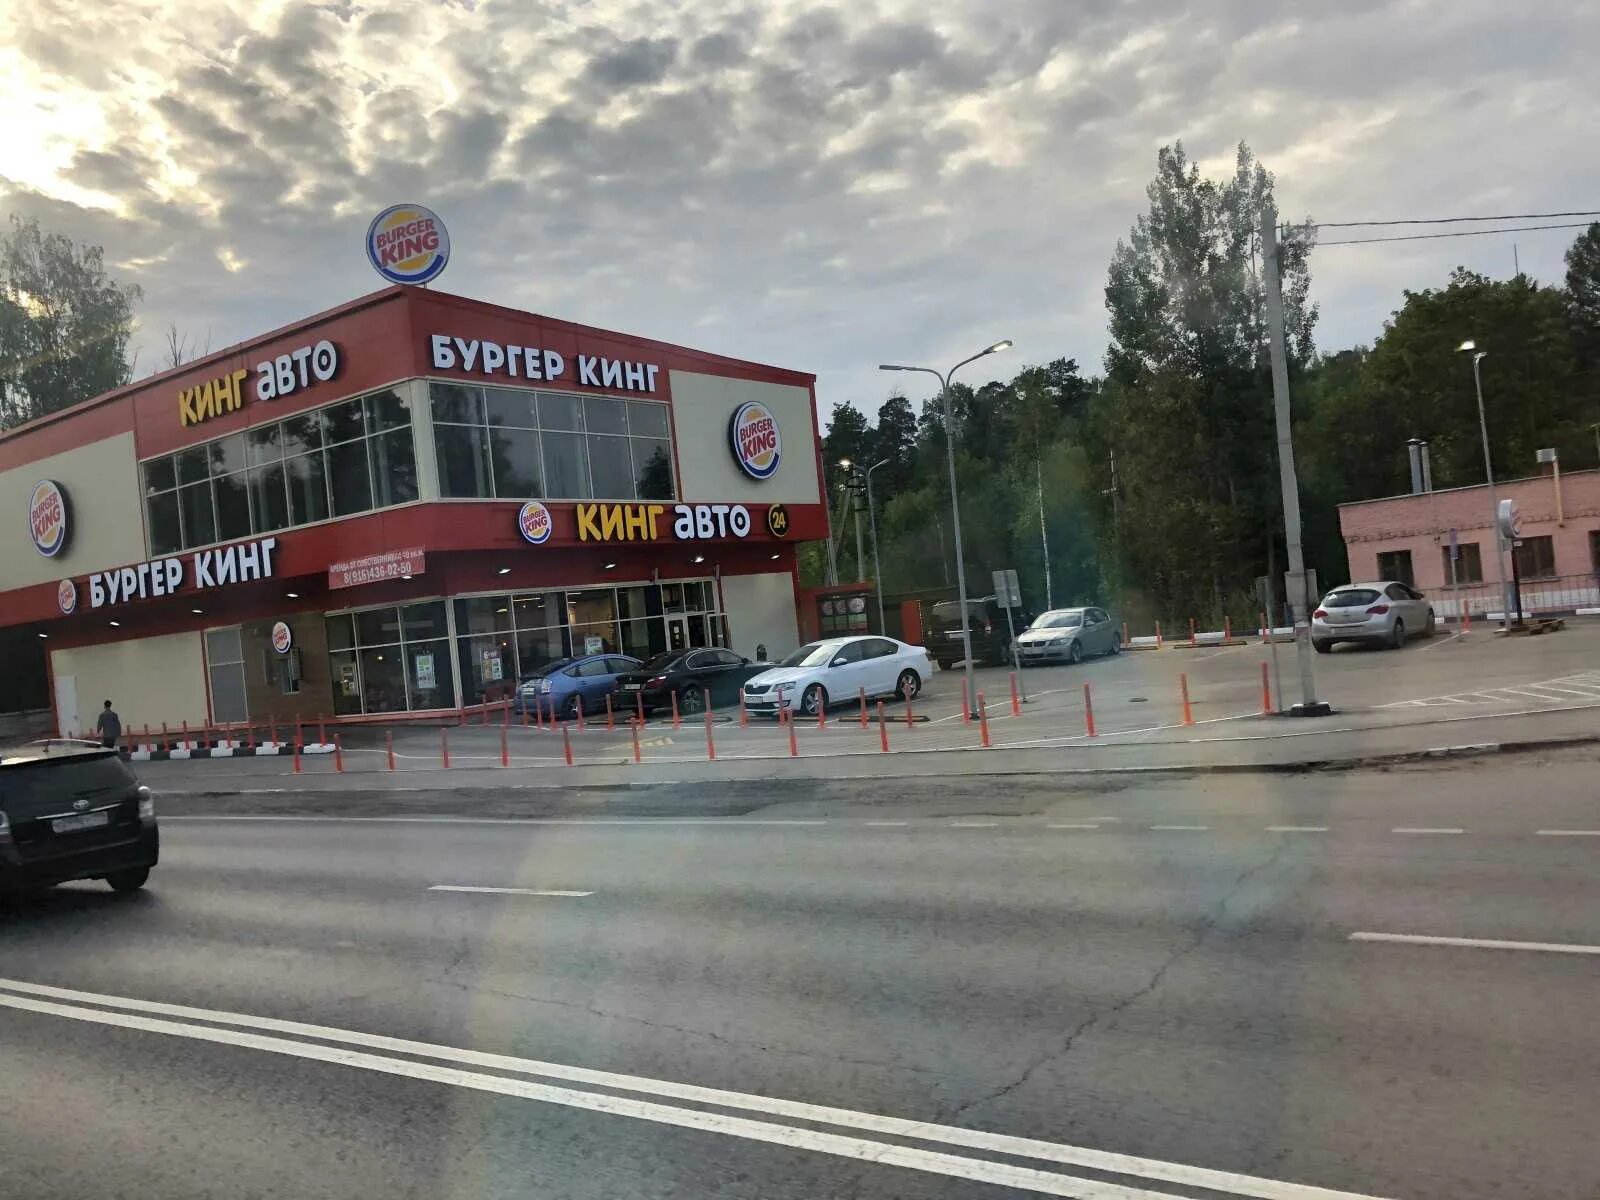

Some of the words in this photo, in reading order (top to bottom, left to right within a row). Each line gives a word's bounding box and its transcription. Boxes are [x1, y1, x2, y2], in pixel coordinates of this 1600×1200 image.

[377, 218, 434, 249] BURGER
[381, 231, 439, 267] KING
[431, 334, 565, 381] БУРГЕР
[578, 354, 659, 392] КИНГ
[740, 418, 773, 443] BURGER
[743, 430, 776, 462] KING
[32, 492, 58, 524] BURGER
[34, 504, 60, 540] KING
[523, 510, 546, 525] BURGER
[772, 511, 785, 529] 24
[525, 516, 548, 535] KING
[89, 558, 183, 608] БУРГЕР
[194, 538, 275, 589] КИНГ
